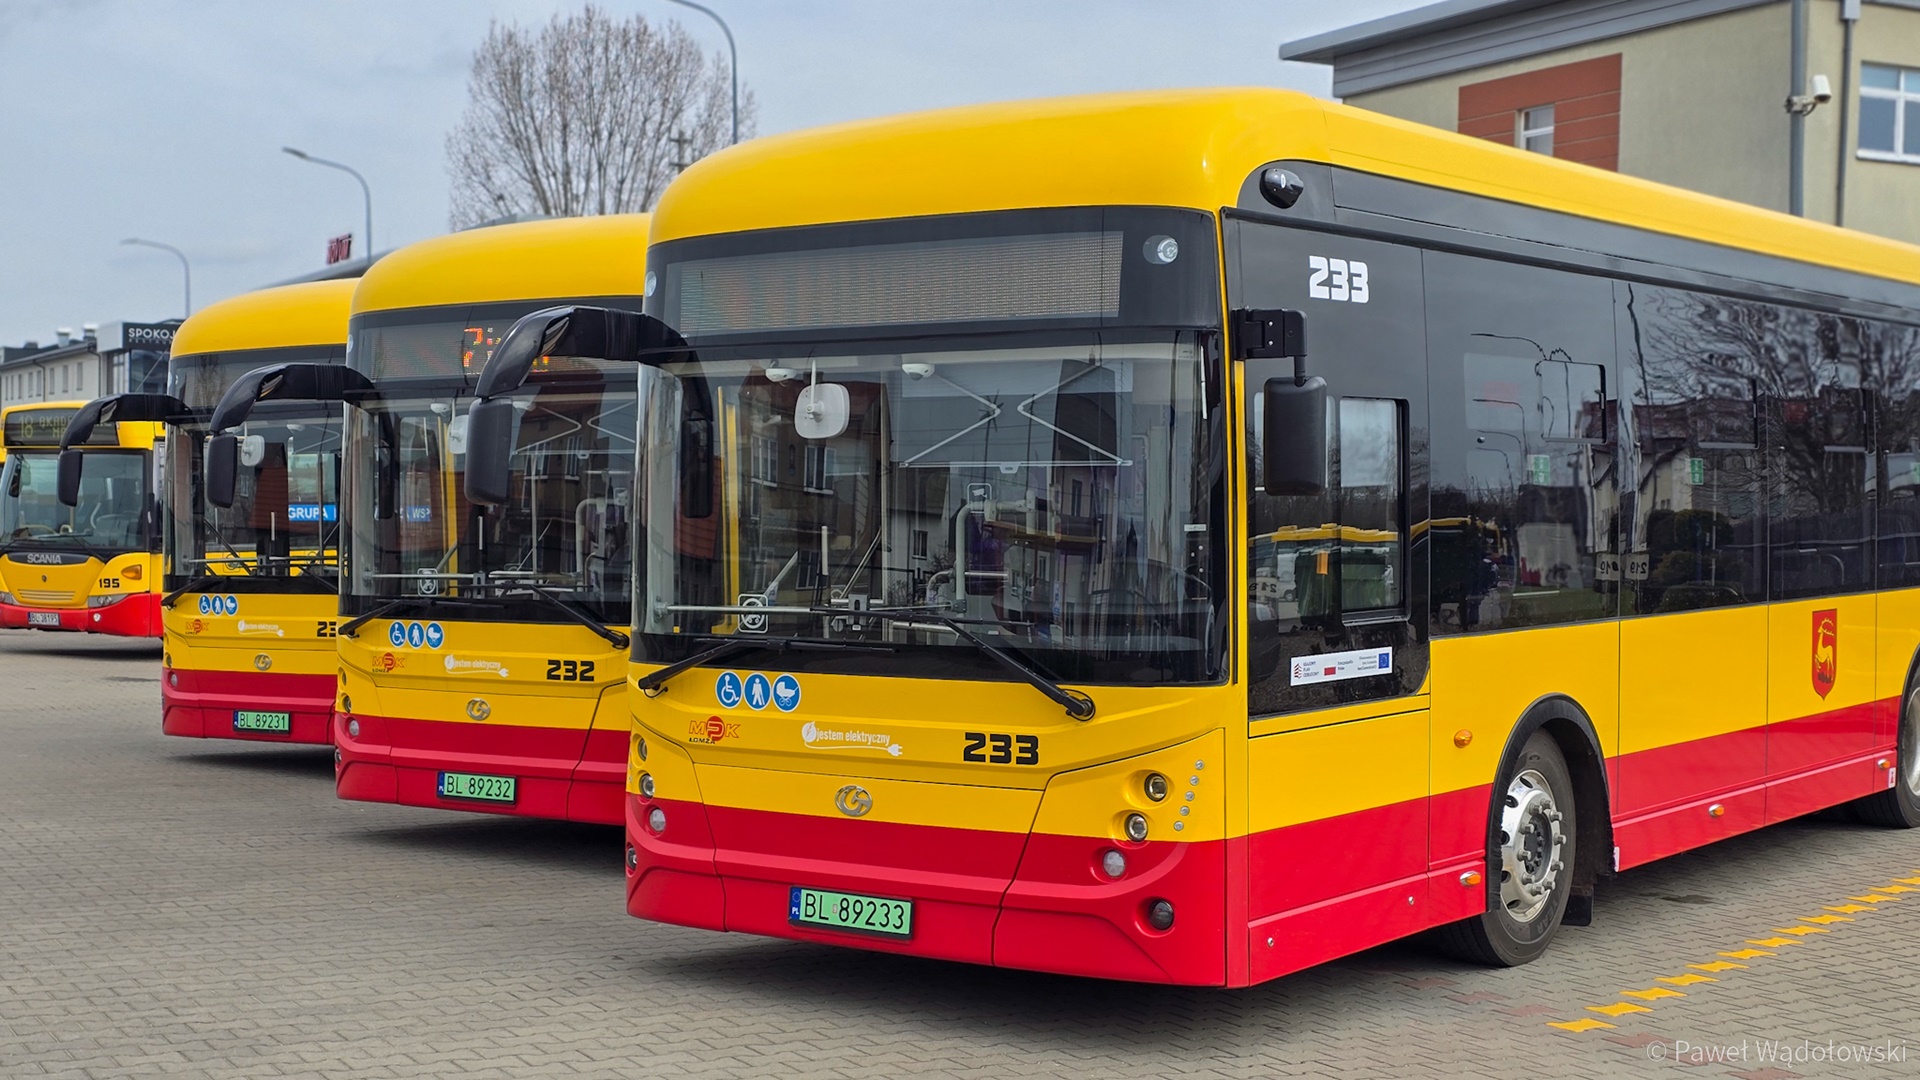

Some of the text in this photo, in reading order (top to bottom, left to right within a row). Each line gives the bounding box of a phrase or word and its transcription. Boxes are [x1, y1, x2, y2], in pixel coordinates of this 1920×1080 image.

[1309, 256, 1369, 303] 233
[27, 553, 62, 564] SCANIA
[99, 578, 120, 588] 195
[372, 652, 405, 671] MPK
[547, 659, 594, 682] 232
[240, 713, 285, 729] BL 89231
[689, 716, 741, 741] MPK
[817, 728, 890, 746] jestem elektryczny
[963, 732, 1038, 765] 233
[447, 776, 511, 798] BL 89232
[792, 907, 799, 915] PL
[805, 893, 904, 929] BL 89233
